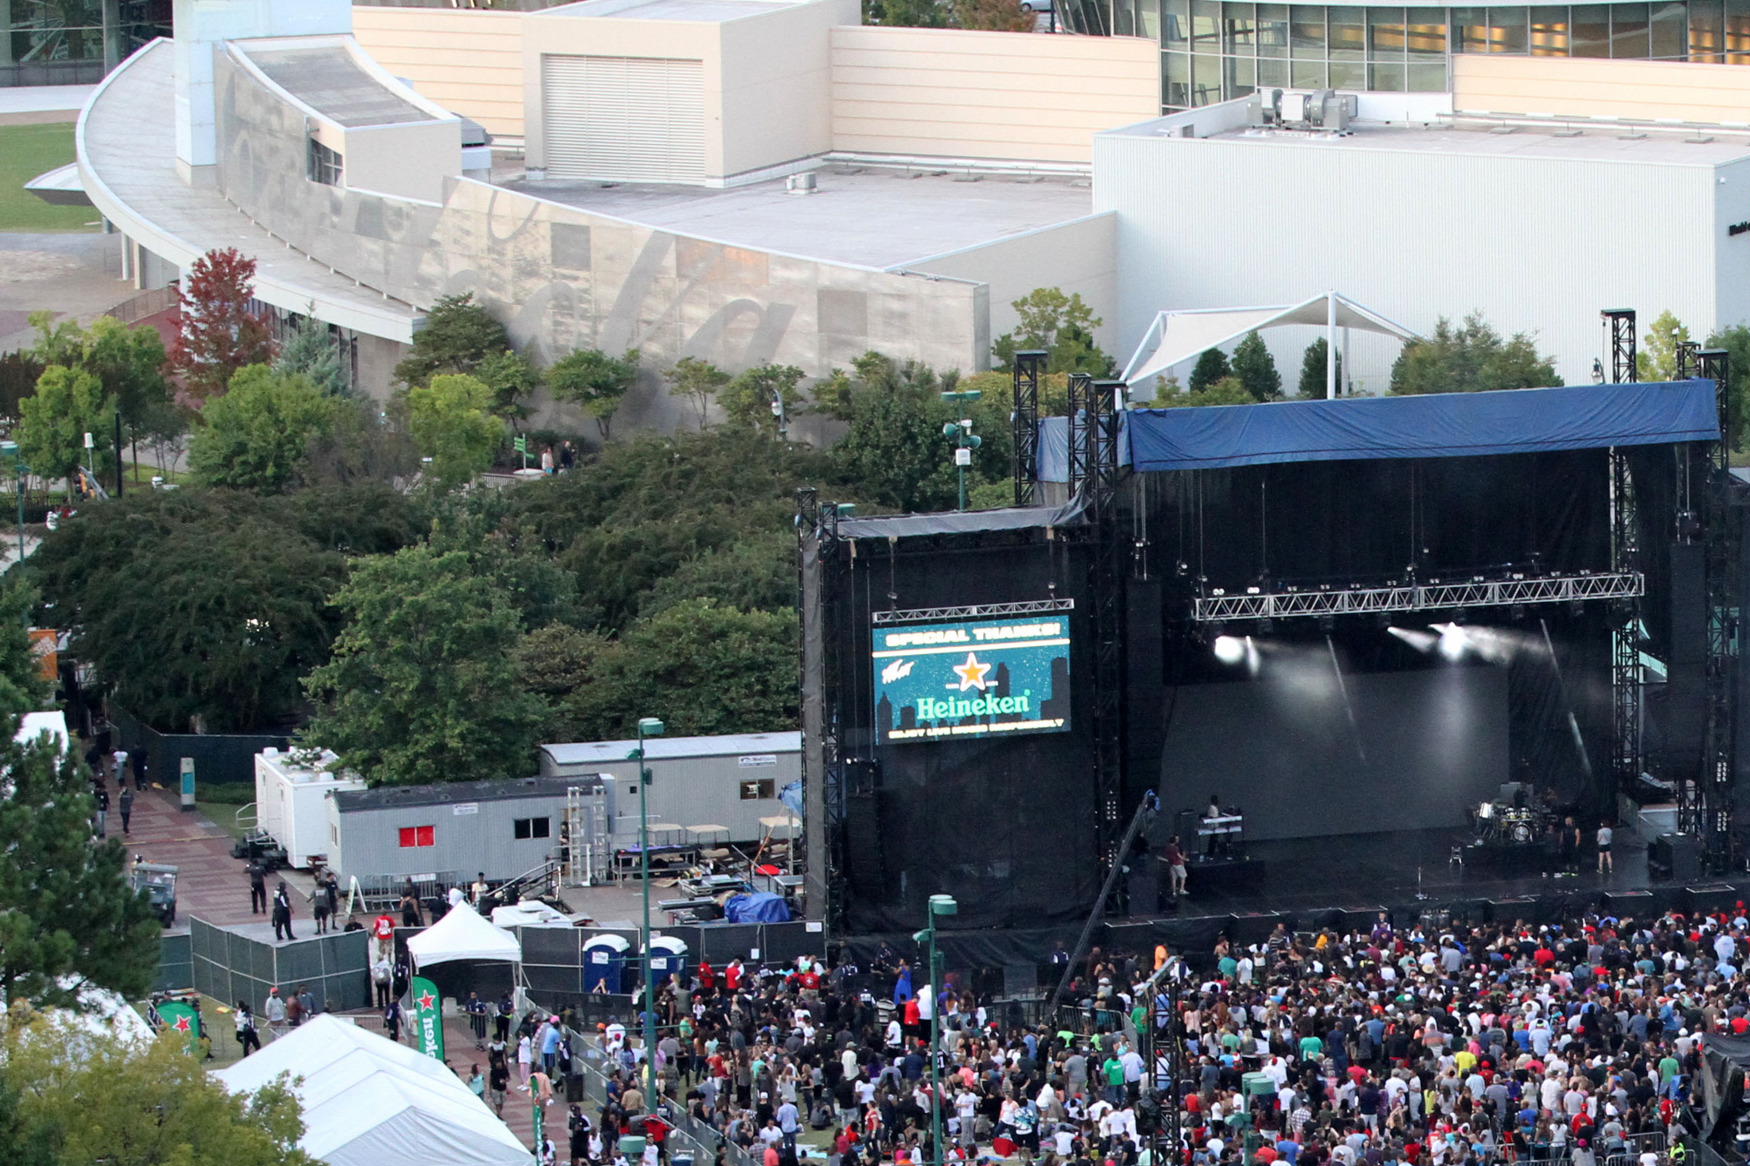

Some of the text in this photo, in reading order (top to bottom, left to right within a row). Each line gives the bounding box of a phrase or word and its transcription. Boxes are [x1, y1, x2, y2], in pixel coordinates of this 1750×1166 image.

[886, 623, 1061, 647] SPECIAL THANKS!
[917, 690, 1030, 720] Heineken
[927, 727, 951, 736] LIVE
